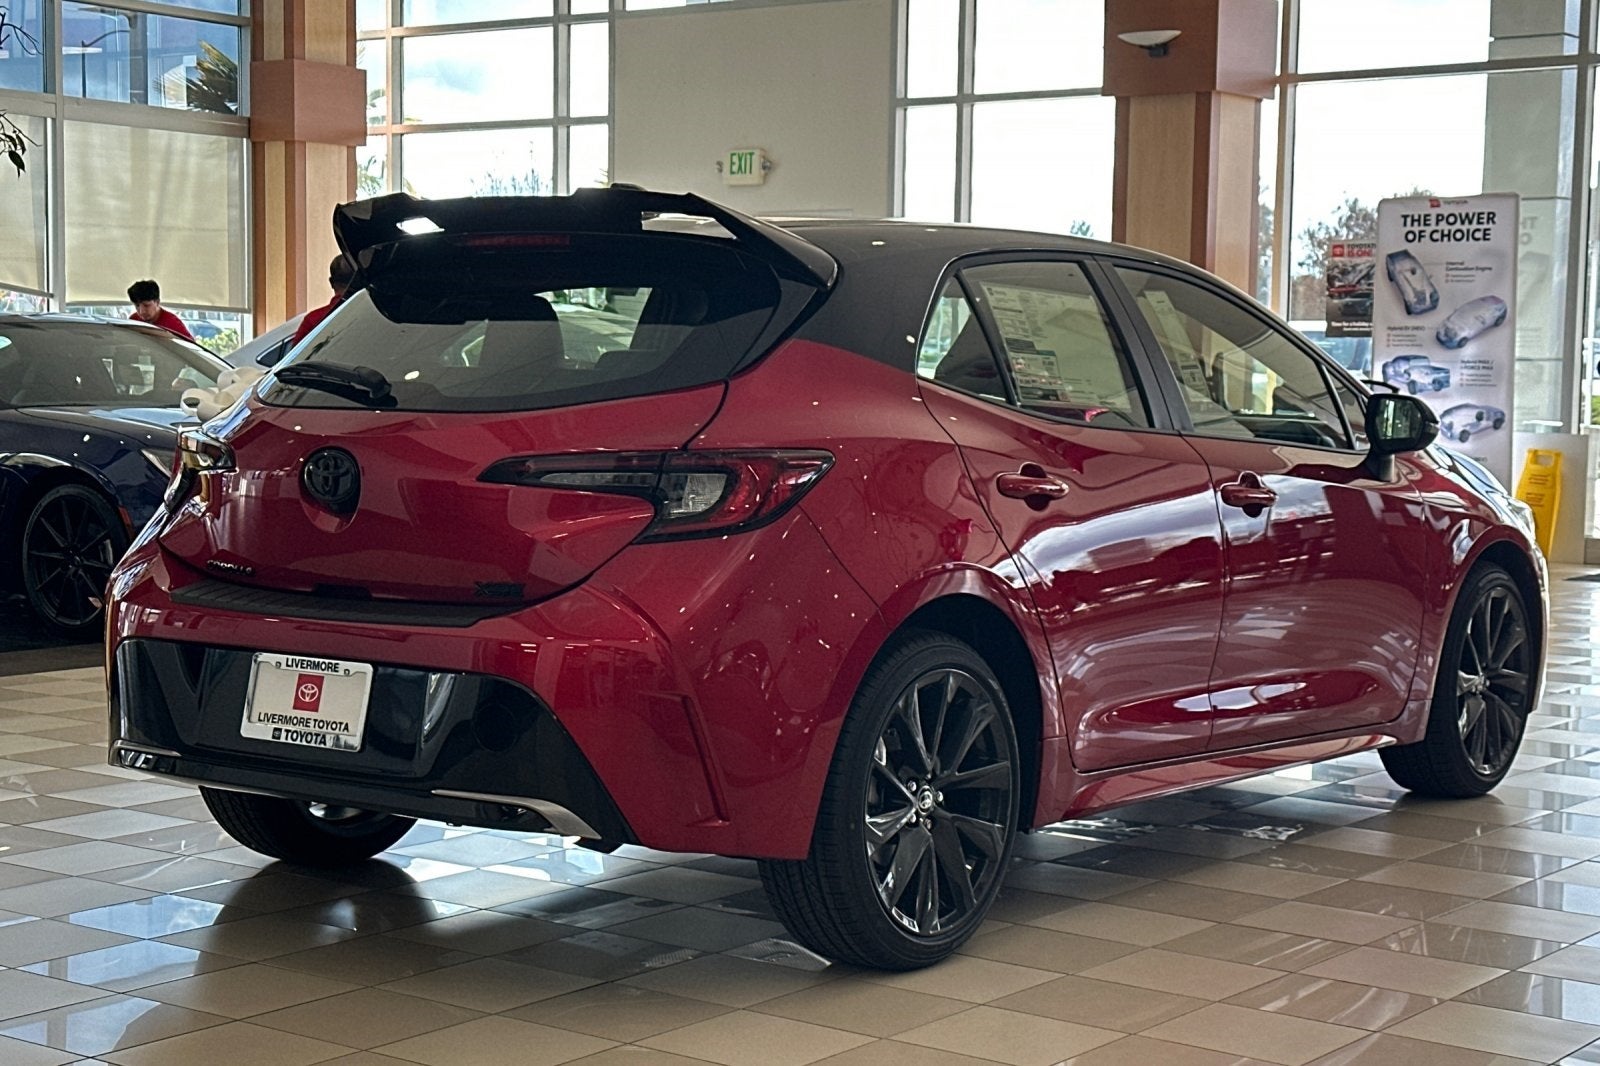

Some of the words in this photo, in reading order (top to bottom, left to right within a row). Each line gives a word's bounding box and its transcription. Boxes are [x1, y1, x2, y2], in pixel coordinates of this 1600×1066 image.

[729, 152, 755, 175] EXIT
[1401, 214, 1431, 227] THE
[1435, 211, 1496, 227] POWER
[1405, 230, 1426, 243] OF
[1430, 228, 1491, 242] CHOICE
[286, 658, 340, 673] LIVERMORE
[258, 712, 311, 728] LIVERMORE
[313, 719, 349, 733] TOYOTA
[284, 729, 327, 746] TOYOTA
